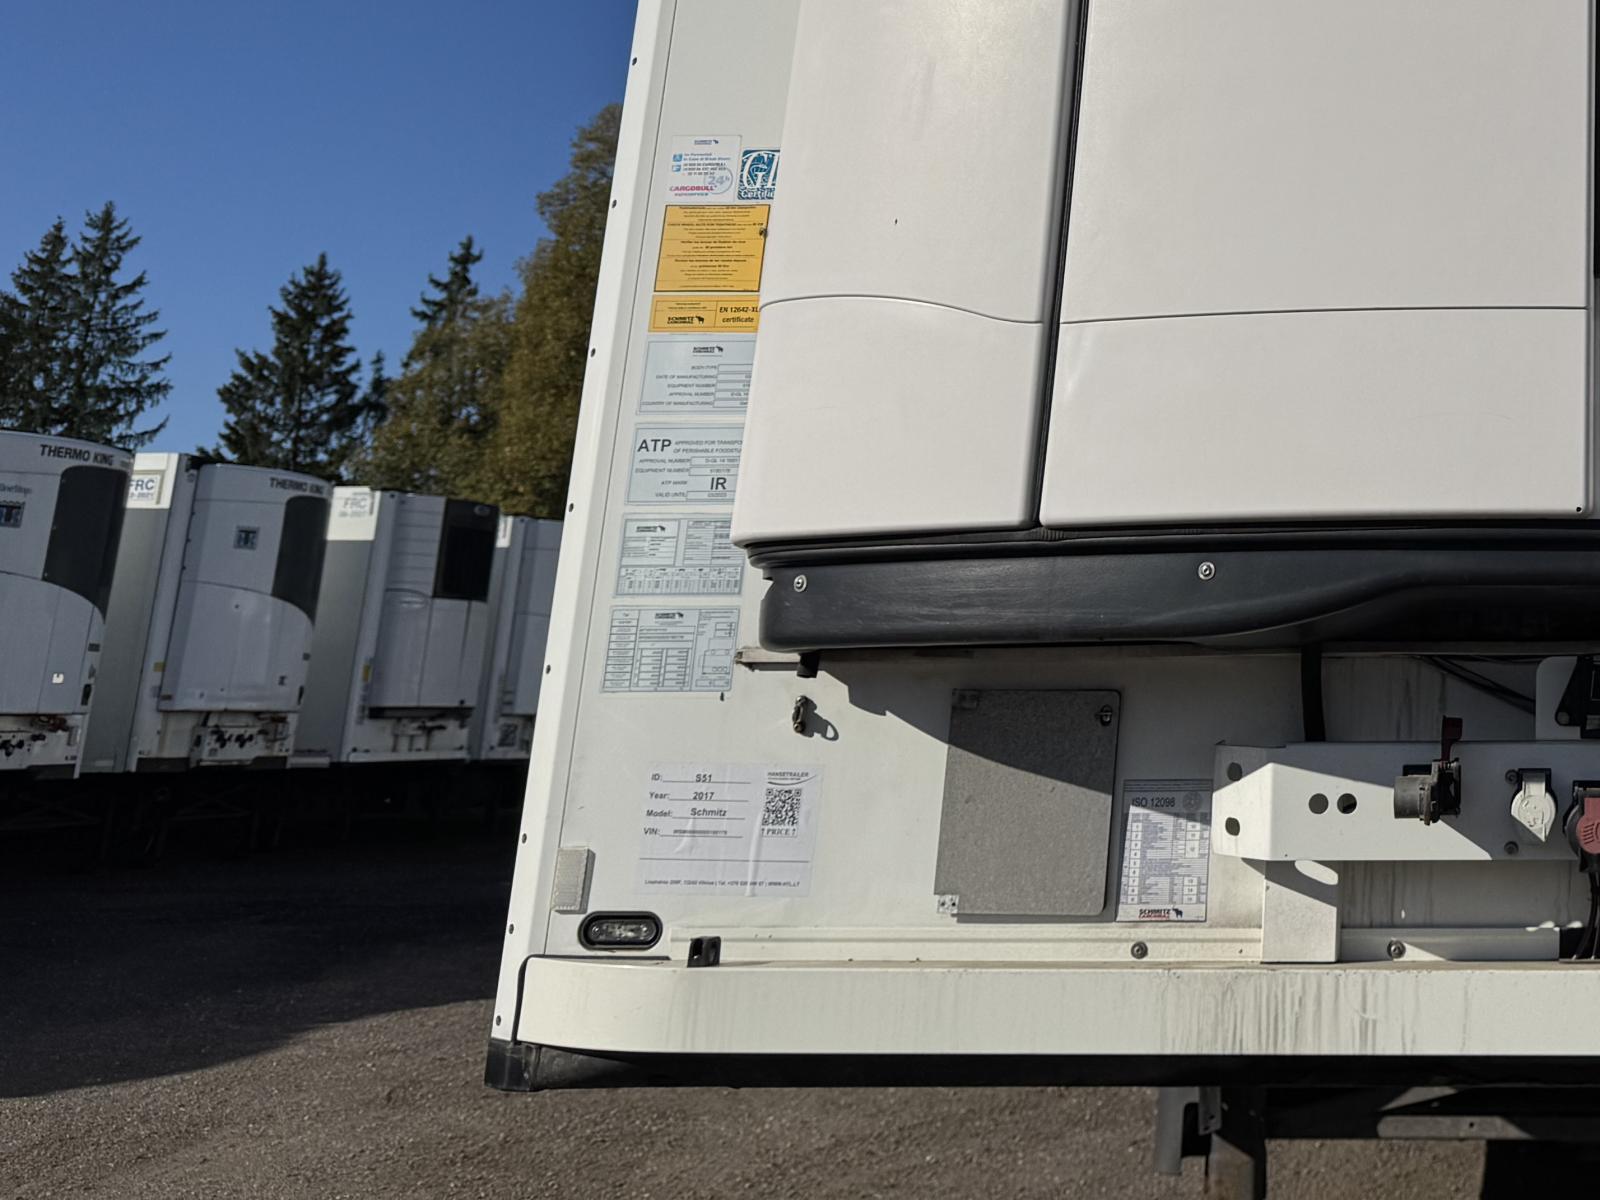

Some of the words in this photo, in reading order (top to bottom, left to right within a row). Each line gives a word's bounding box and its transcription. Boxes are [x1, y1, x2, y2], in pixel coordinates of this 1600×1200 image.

[637, 439, 672, 452] ATP
[40, 444, 90, 462] THERMO
[710, 476, 727, 490] IR
[695, 773, 713, 782] S51
[649, 791, 670, 799] Year:
[692, 791, 715, 800] 2017
[1132, 797, 1148, 808] ISO
[646, 809, 673, 817] Model:
[690, 807, 727, 817] Schmitz
[644, 828, 661, 836] VIN:
[767, 828, 790, 836] PRICE
